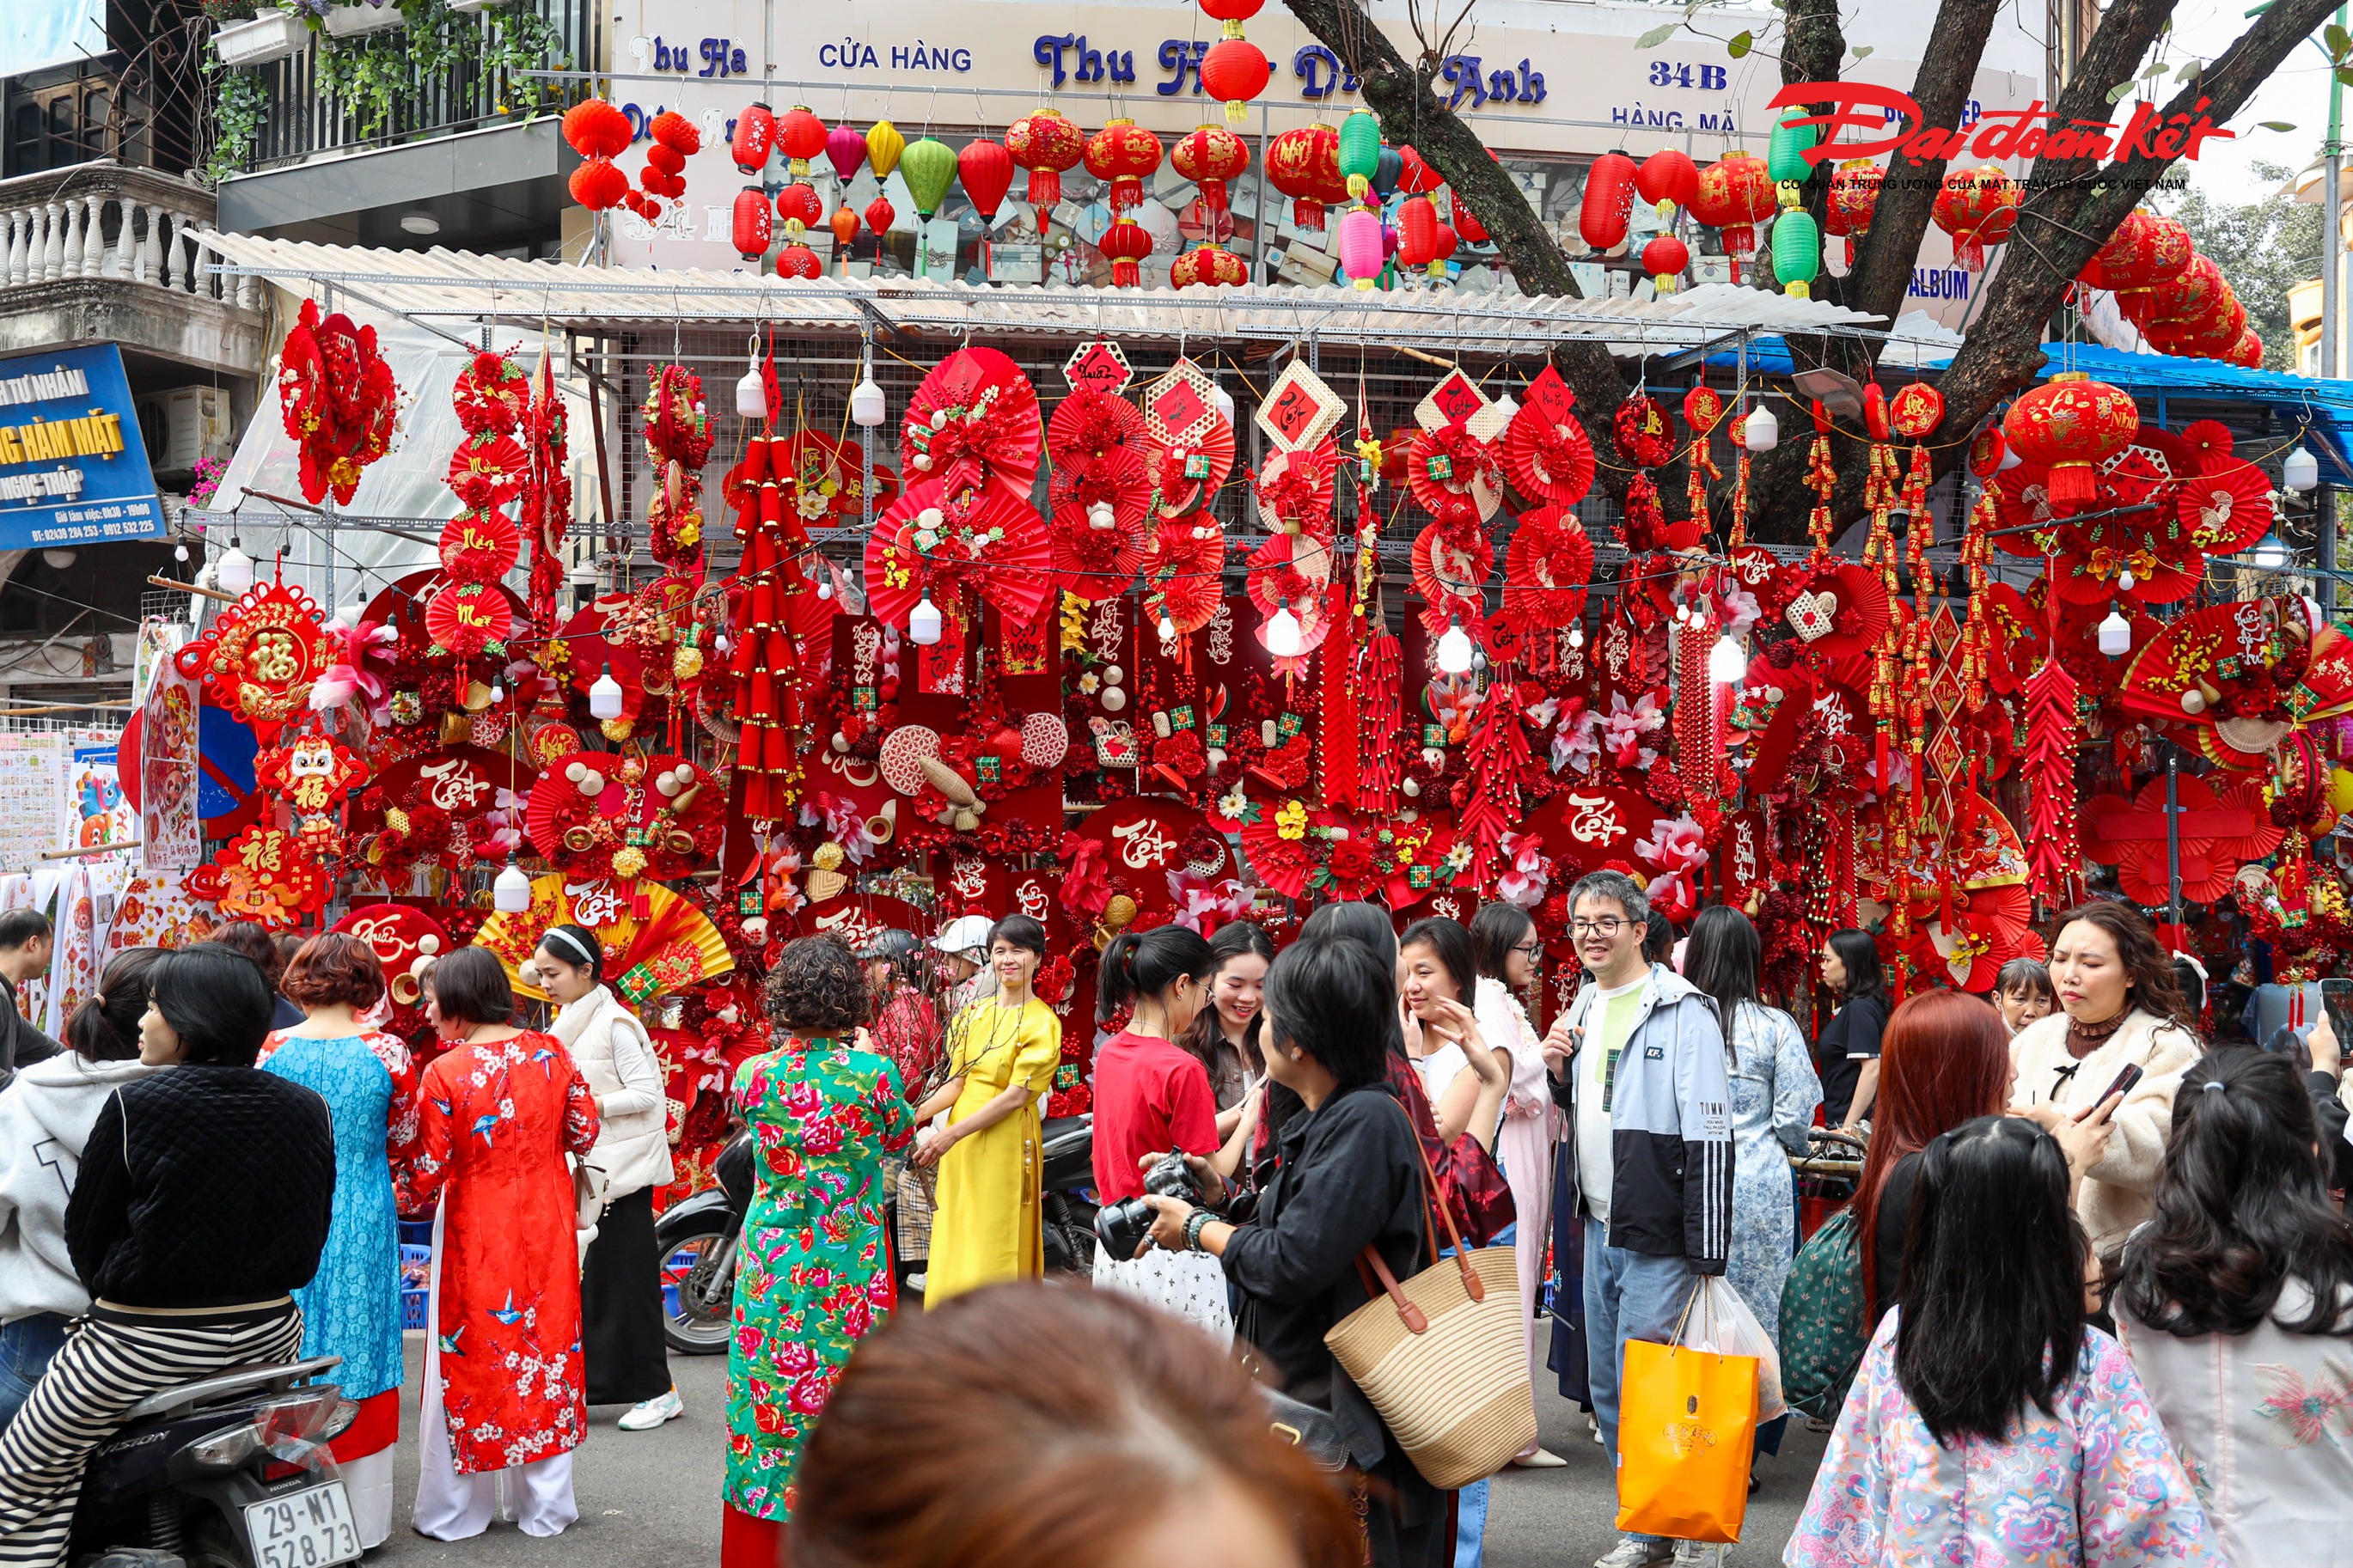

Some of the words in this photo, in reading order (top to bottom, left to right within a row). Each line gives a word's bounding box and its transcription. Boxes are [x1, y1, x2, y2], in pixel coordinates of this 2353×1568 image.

[699, 37, 747, 77] Hà
[819, 37, 879, 69] CỬA
[891, 40, 972, 72] HÀNG
[1033, 32, 1135, 89] Thu
[1649, 61, 1727, 90] 34B
[1612, 101, 1684, 128] HÀNG
[1700, 109, 1734, 131] MÃ
[1909, 268, 1968, 300] ALBUM
[8, 374, 38, 405] TƯ
[32, 364, 89, 401] NHÂN
[19, 415, 77, 461] HÀM
[70, 408, 124, 460] MẶT
[1, 473, 46, 505] NGỌC
[42, 465, 83, 501] THẬP
[44, 528, 68, 540] 02439
[68, 526, 83, 539] 284
[83, 524, 98, 537] 253
[103, 522, 122, 535] 0912
[123, 521, 138, 534] 532
[138, 520, 155, 533] 225
[55, 510, 68, 523] Giờ
[70, 509, 83, 522] làm
[84, 508, 102, 522] việc:
[102, 506, 121, 520] 8h30
[126, 503, 150, 516] 19h00
[1737, 551, 1775, 584] Tết
[294, 777, 329, 808] 福
[420, 758, 491, 810] Tết
[1568, 793, 1627, 847] Tết
[239, 830, 281, 871] 福
[1112, 819, 1177, 869] Tết
[565, 878, 623, 927] Tết
[351, 914, 417, 962] Xuân
[96, 1431, 171, 1457] VISION
[269, 1480, 303, 1492] HONDA
[263, 1489, 337, 1540] 29-N1
[261, 1523, 355, 1568] 528.73
